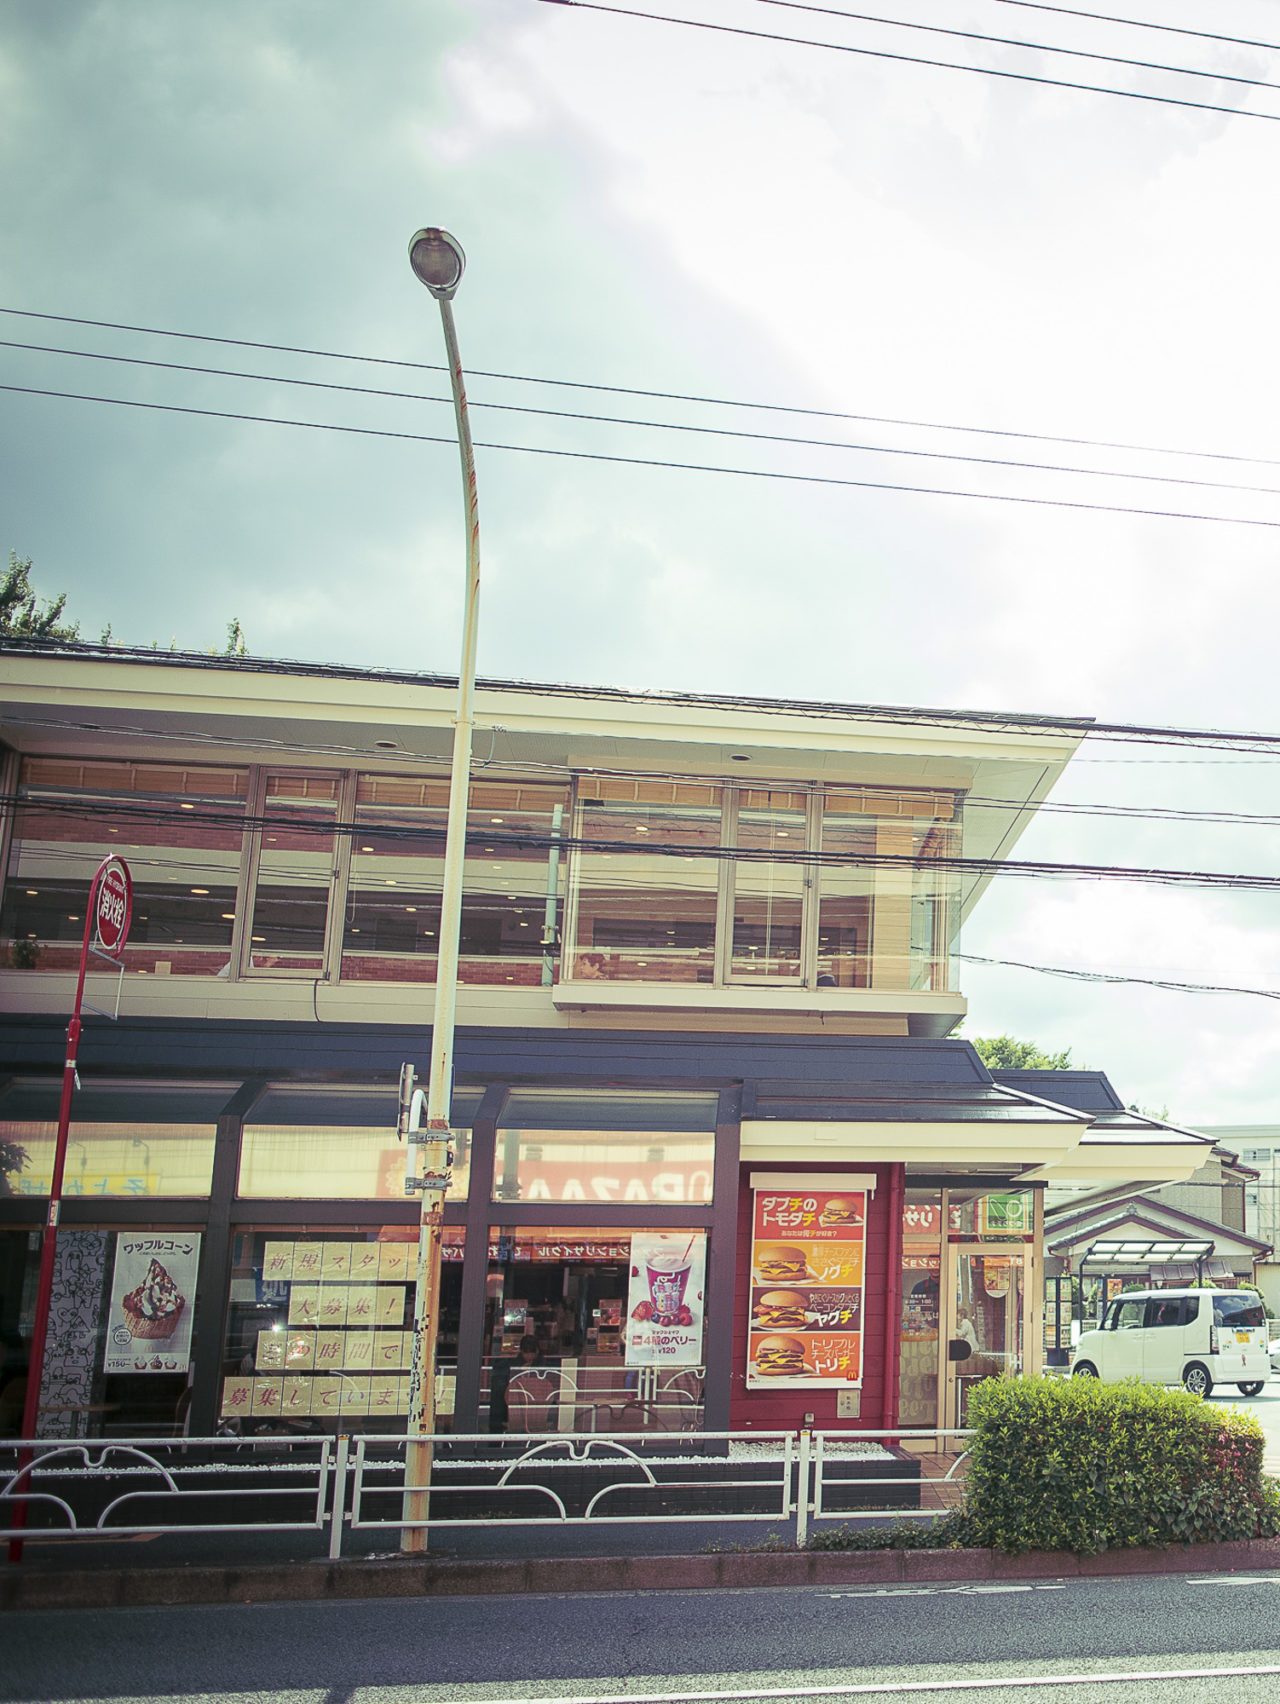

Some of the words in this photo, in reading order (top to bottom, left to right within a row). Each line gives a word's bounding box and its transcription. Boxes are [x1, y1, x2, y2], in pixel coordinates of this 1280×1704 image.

[100, 888, 124, 929] 消火栓
[762, 1197, 818, 1211] ダブチの
[762, 1212, 816, 1227] トモダチ
[123, 1239, 194, 1255] ワッフルコーン
[269, 1252, 402, 1271] 新規スタッ
[818, 1264, 853, 1281] ノグチ
[817, 1309, 853, 1327] ヤグチ
[658, 1347, 676, 1355] ¥120
[811, 1339, 856, 1349] トリプル
[811, 1349, 855, 1359] チーズバーガー
[814, 1356, 851, 1374] トリチ
[228, 1388, 446, 1406] 募集していま!
